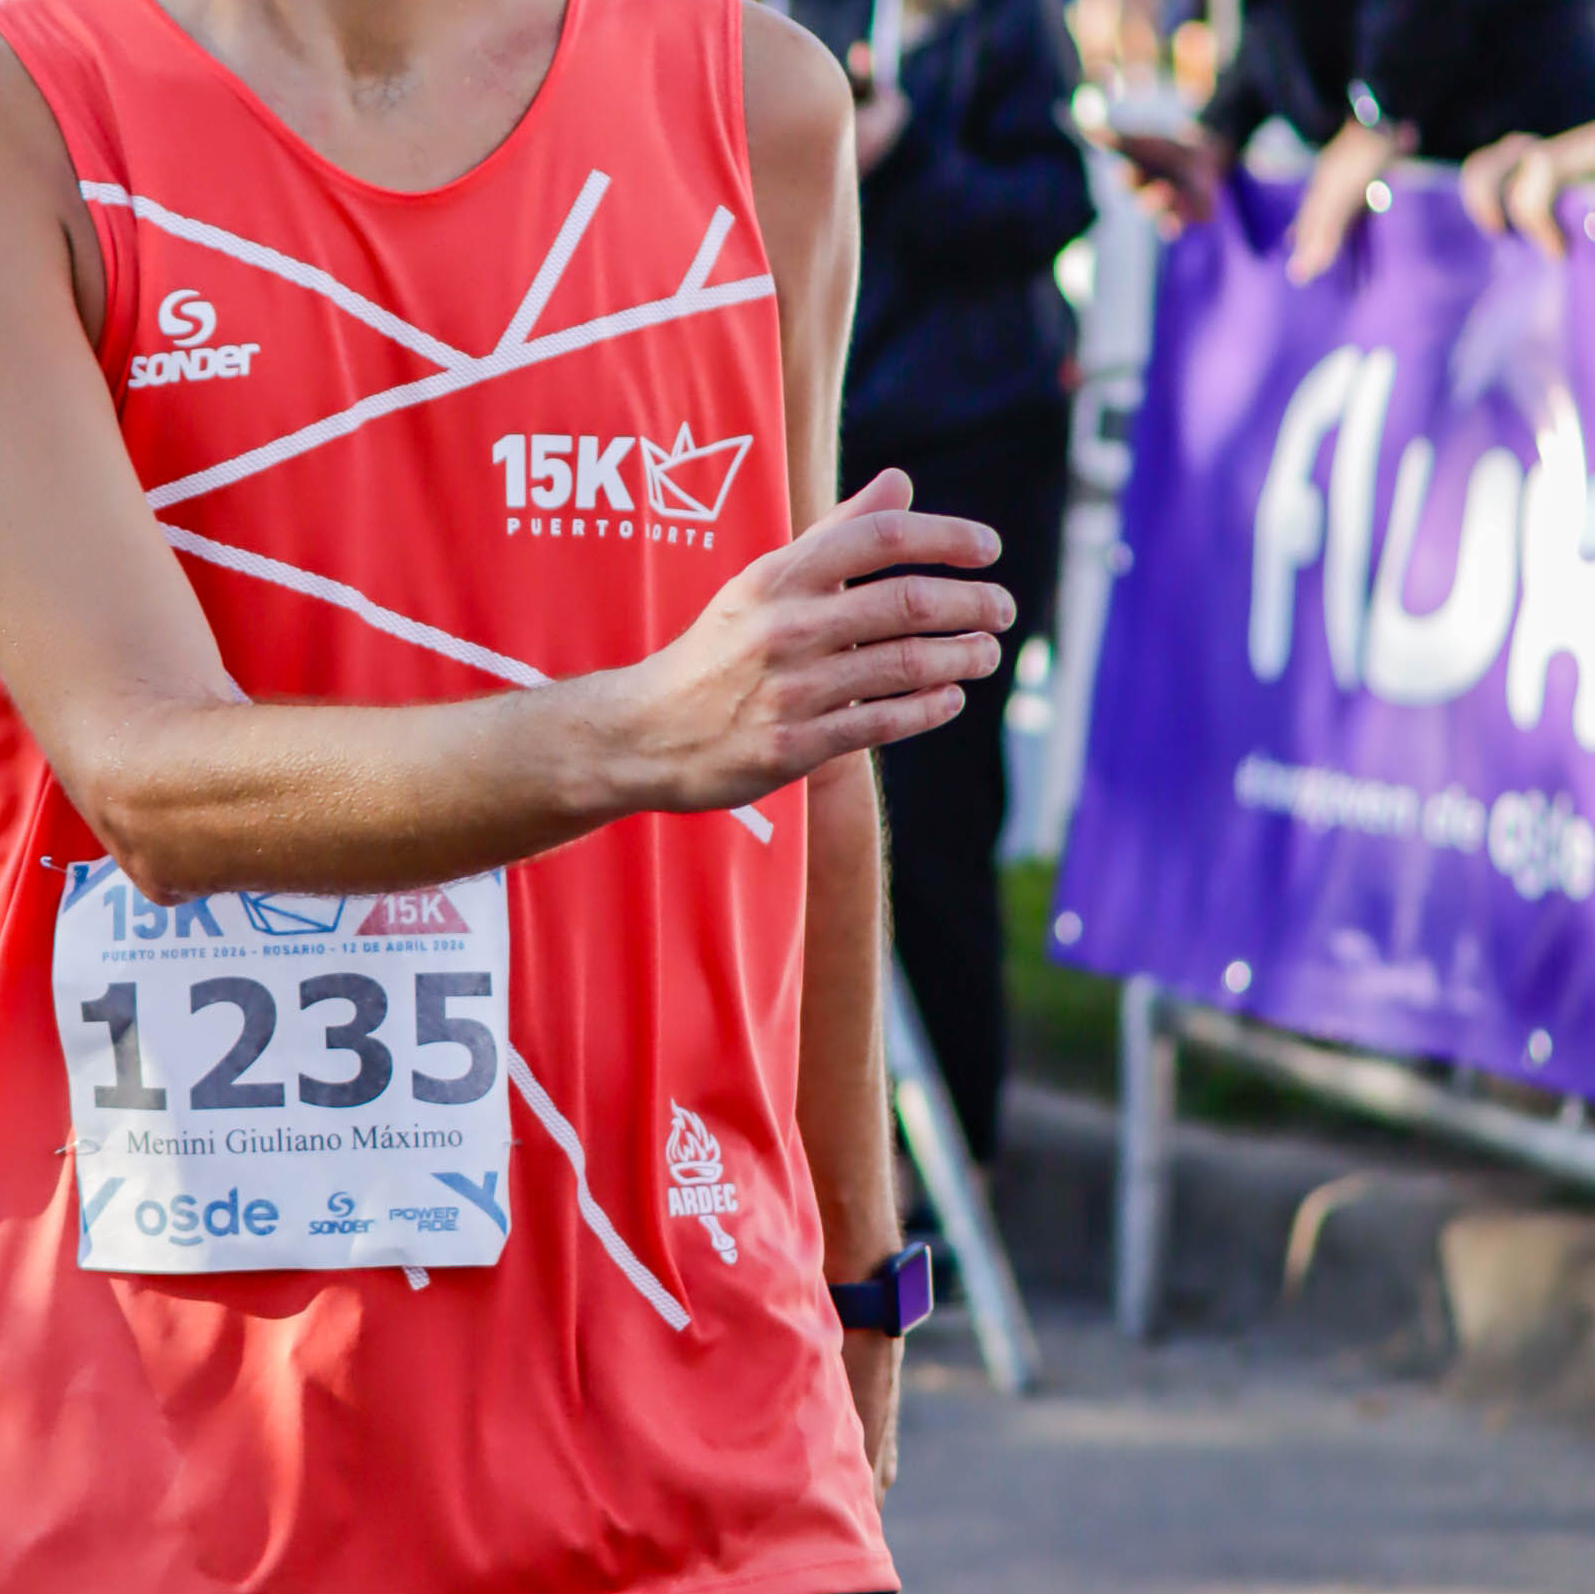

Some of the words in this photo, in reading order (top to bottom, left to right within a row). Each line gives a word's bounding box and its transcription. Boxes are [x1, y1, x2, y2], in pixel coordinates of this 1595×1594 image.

[492, 433, 636, 511] 15K
[506, 517, 634, 539] PUERTO
[103, 883, 224, 941] 15K
[380, 892, 445, 925] 15K
[101, 949, 155, 962] PUERTO
[160, 946, 207, 959] NORTE
[262, 943, 326, 955] ROSARIO
[342, 941, 356, 954] 12
[363, 940, 380, 953] DE
[386, 939, 428, 952] ABRIL
[433, 939, 466, 951] 2026
[80, 972, 498, 1112] 1235
[127, 1128, 216, 1155] Menini
[225, 1126, 343, 1154] Giuliano
[351, 1123, 463, 1151] Máximo
[134, 1186, 280, 1245] osde
[389, 1206, 460, 1221] POWER
[667, 1182, 739, 1218] ARDEC
